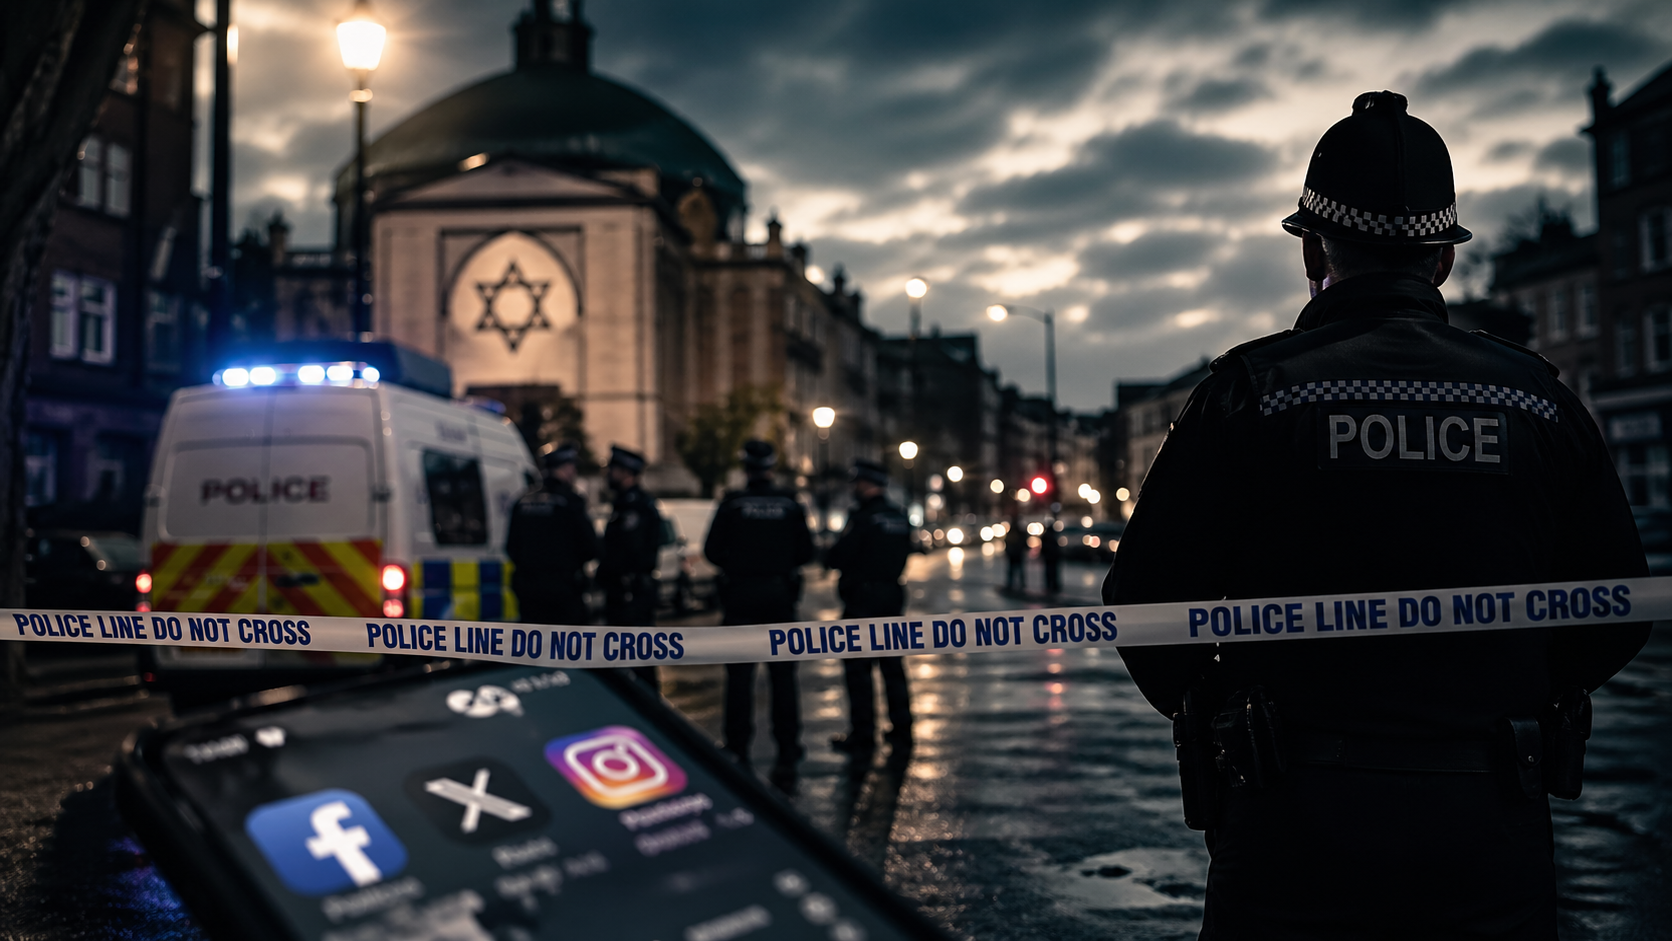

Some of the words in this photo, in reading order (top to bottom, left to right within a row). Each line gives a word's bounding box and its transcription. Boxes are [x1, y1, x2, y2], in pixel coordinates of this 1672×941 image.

[1328, 414, 1500, 463] POLICE
[200, 475, 331, 506] POLICE
[12, 613, 94, 638] POLICE
[97, 615, 148, 640] LINE
[151, 616, 183, 641] DO
[187, 617, 231, 643] NOT
[237, 618, 311, 646] CROSS
[769, 625, 862, 656] POLICE
[869, 621, 925, 651] LINE
[932, 619, 967, 649] DO
[975, 616, 1024, 647] NOT
[1032, 611, 1118, 644] CROSS
[1188, 603, 1304, 638] POLICE
[1315, 599, 1388, 632] LINE
[1398, 595, 1442, 628] DO
[1452, 592, 1515, 626] NOT
[1525, 584, 1631, 622] CROSS
[366, 623, 448, 653] POLICE
[454, 626, 505, 656] LINE
[511, 629, 543, 659] DO
[549, 631, 597, 661] NOT
[603, 631, 684, 662] CROSS
[306, 800, 381, 887] f
